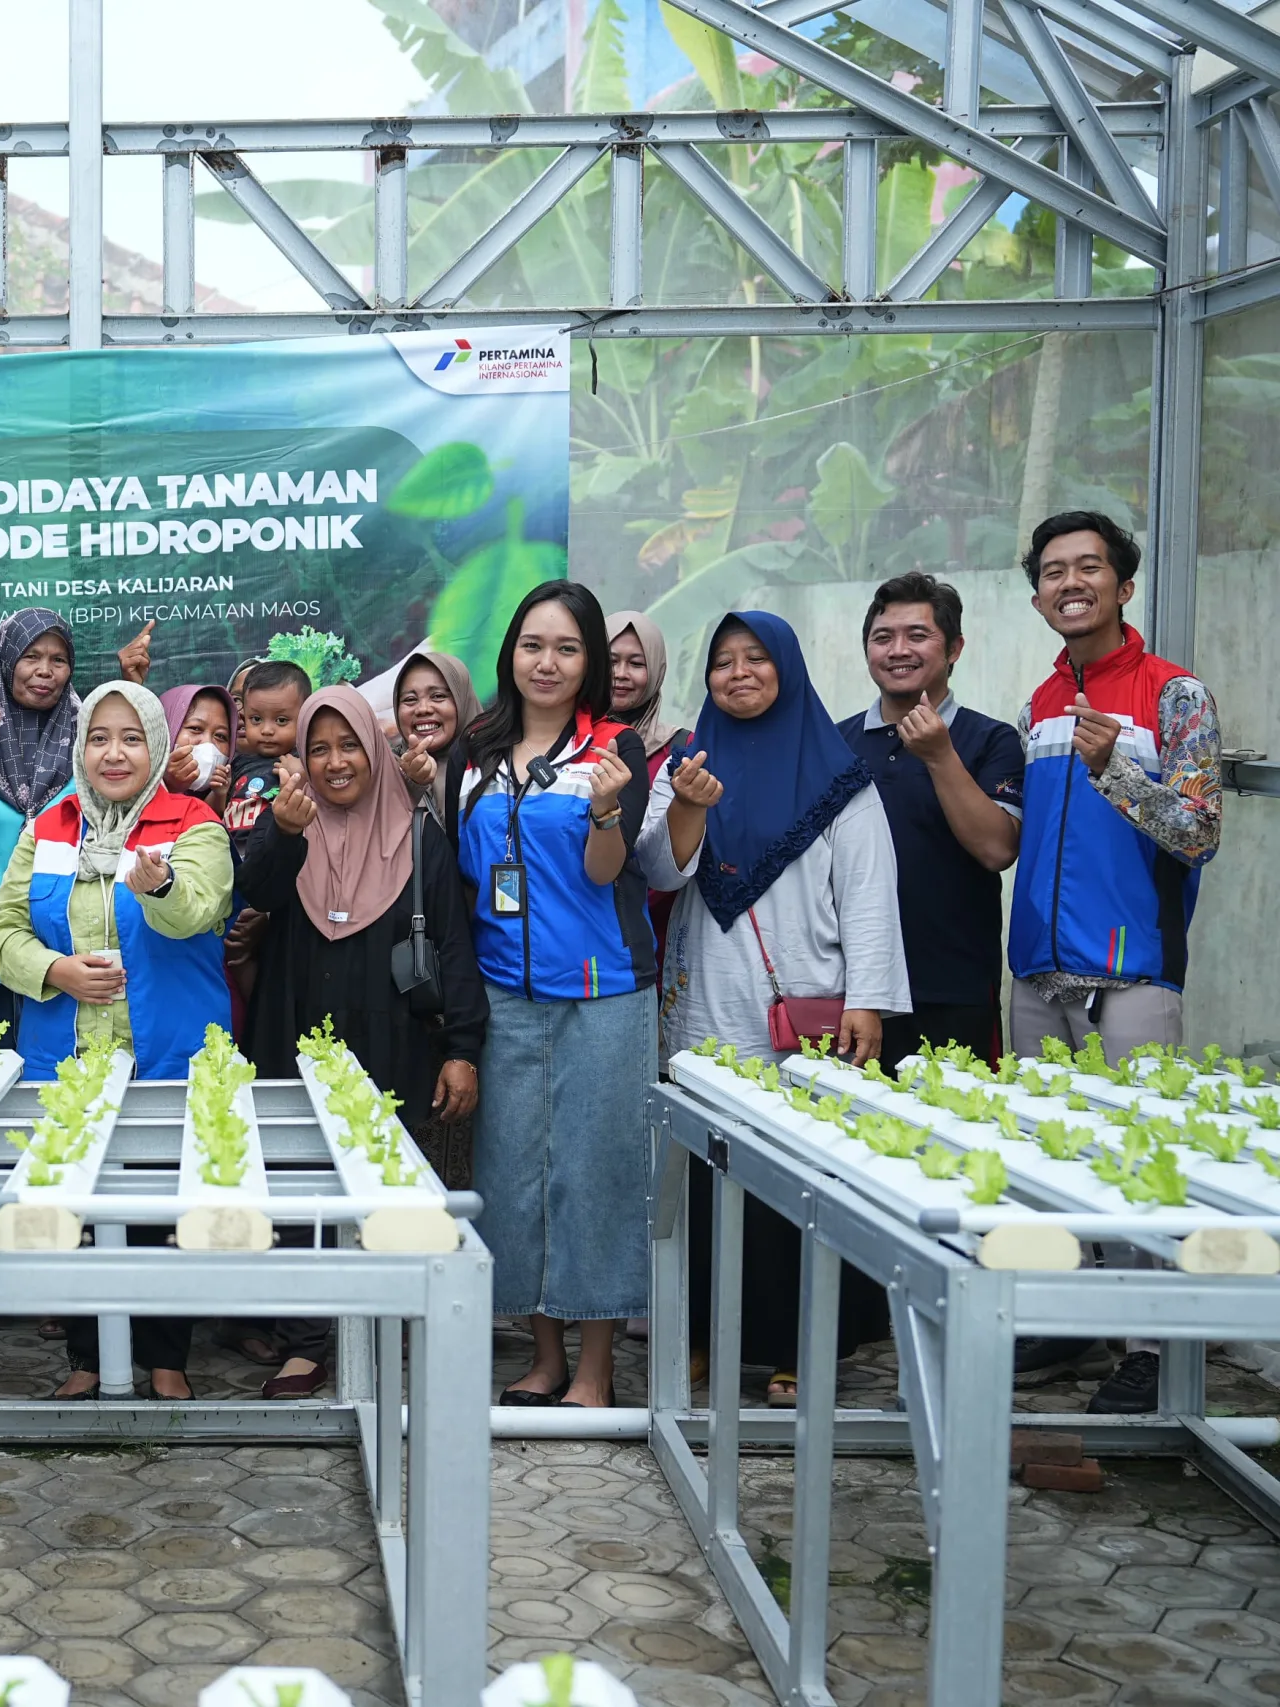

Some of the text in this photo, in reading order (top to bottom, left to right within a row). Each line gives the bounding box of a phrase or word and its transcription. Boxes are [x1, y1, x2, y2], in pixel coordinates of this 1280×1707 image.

[479, 348, 555, 361] PERTAMINA
[479, 361, 563, 371] KILANG PERTAMINA
[479, 371, 548, 380] INTERNASIONAL
[157, 468, 378, 509] TANAMAN
[80, 514, 364, 557] HIDROPONIK
[1, 581, 49, 598] TANI
[55, 579, 112, 597] DESA
[117, 575, 234, 594] KALIJARAN
[69, 606, 121, 627] (BPP)
[129, 602, 254, 622] KECAMATAN
[261, 600, 321, 617] MAOS
